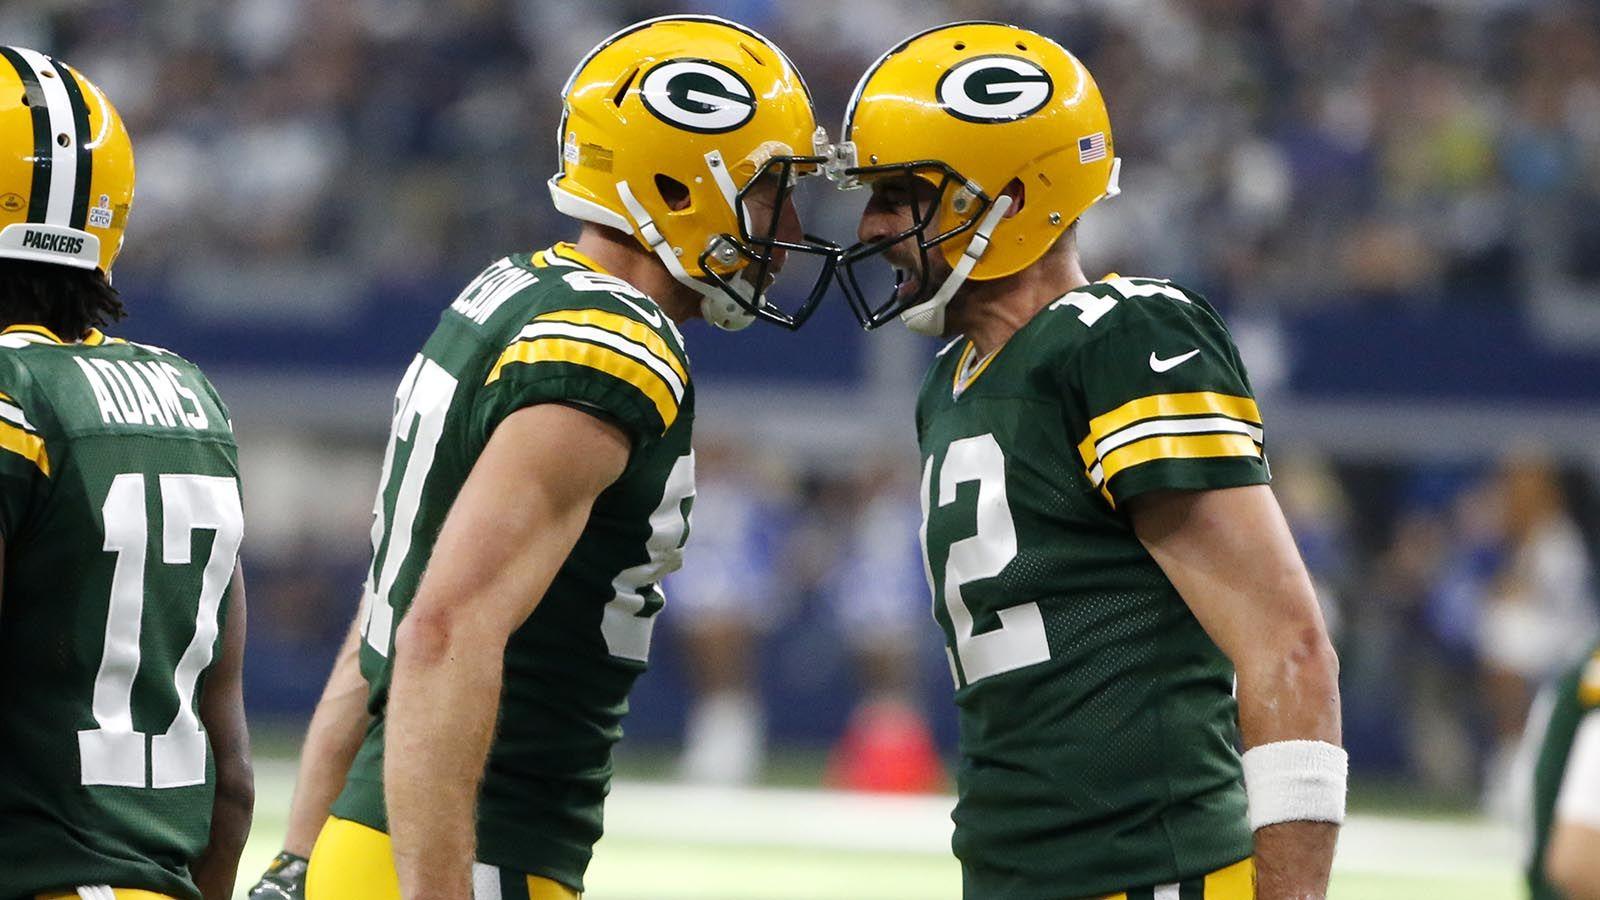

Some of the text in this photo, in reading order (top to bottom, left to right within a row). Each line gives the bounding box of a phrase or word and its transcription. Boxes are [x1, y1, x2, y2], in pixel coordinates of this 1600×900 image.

[22, 229, 84, 254] PACKERS
[90, 214, 110, 225] CATCH
[72, 355, 209, 430] ADAMS
[78, 472, 245, 789] 17
